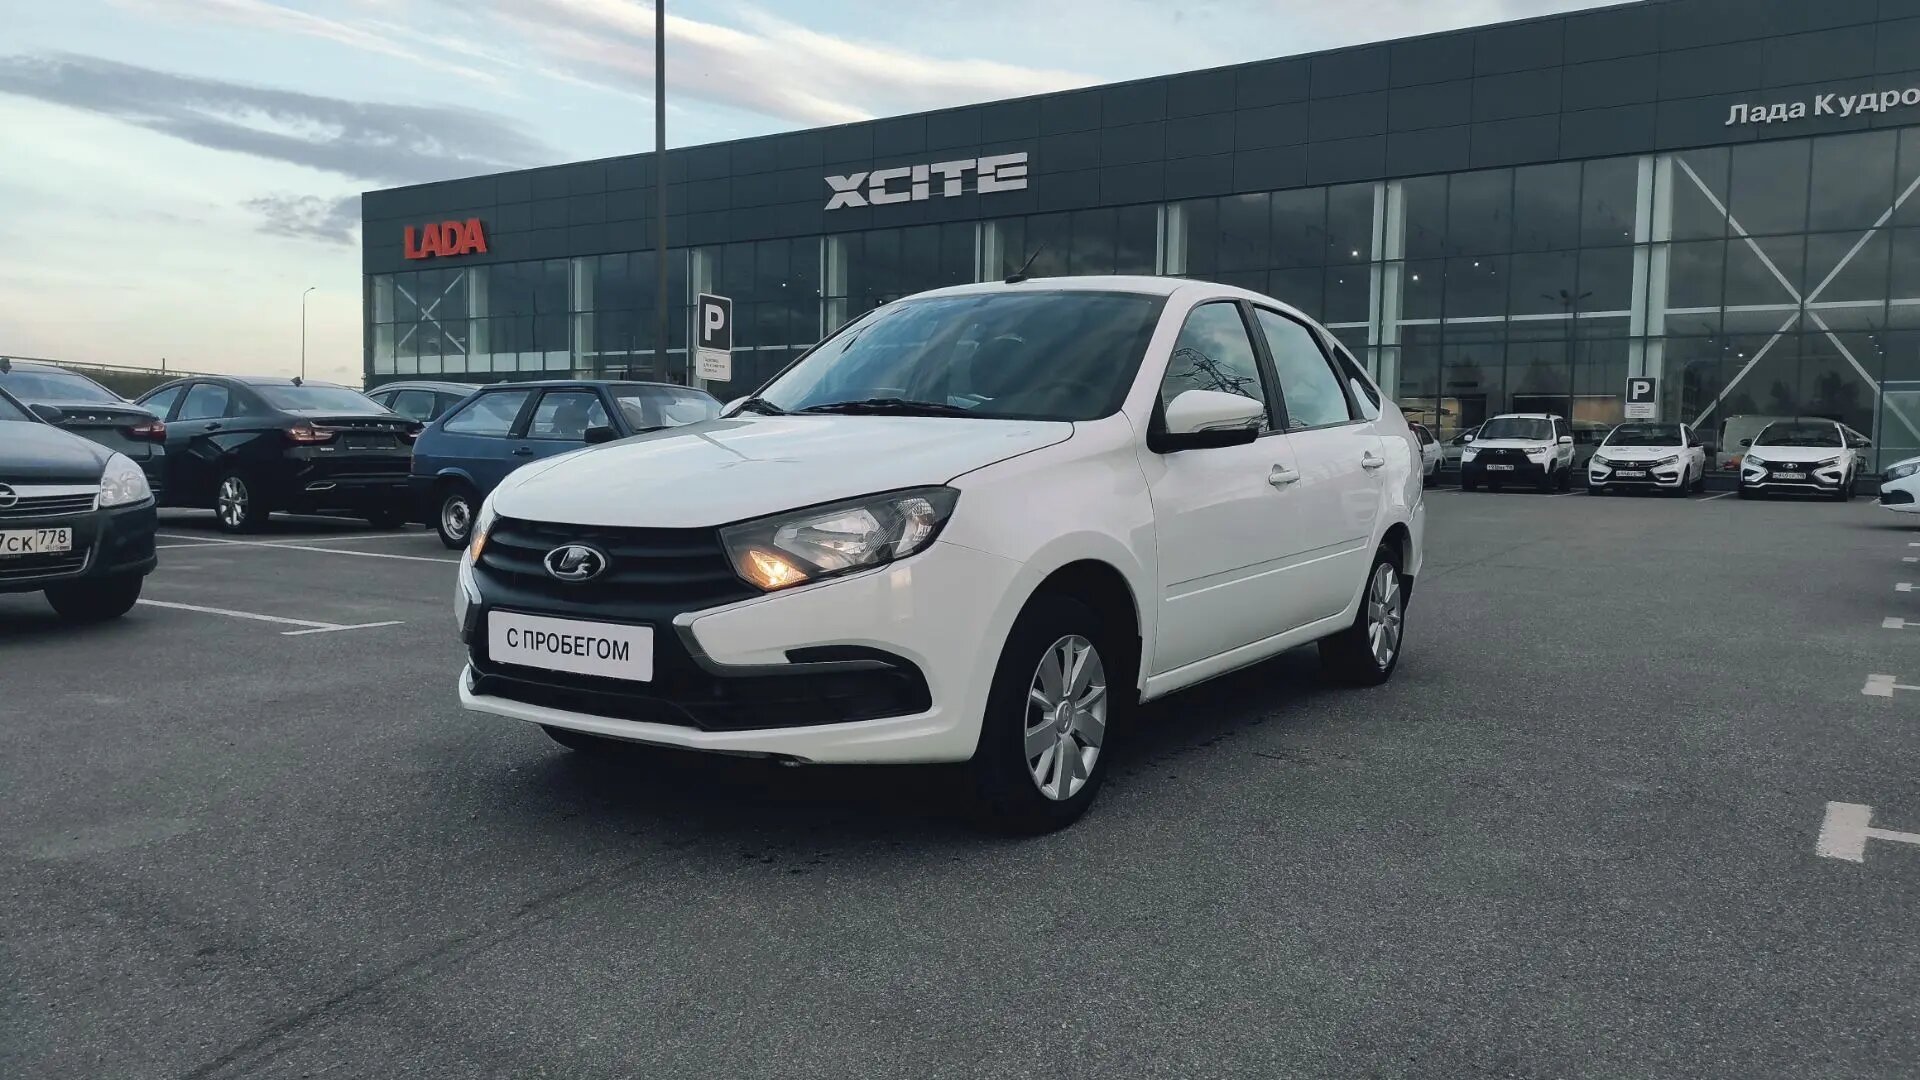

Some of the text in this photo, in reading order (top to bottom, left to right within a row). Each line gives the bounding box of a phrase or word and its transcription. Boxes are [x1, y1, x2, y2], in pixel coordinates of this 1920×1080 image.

[1725, 87, 1920, 126] Лада Кудро
[824, 152, 1029, 211] XCITE
[403, 218, 488, 260] LADA
[704, 303, 725, 341] P
[1632, 381, 1651, 400] P
[38, 529, 67, 545] 778
[507, 627, 629, 662] С ПРОБЕГОМ
